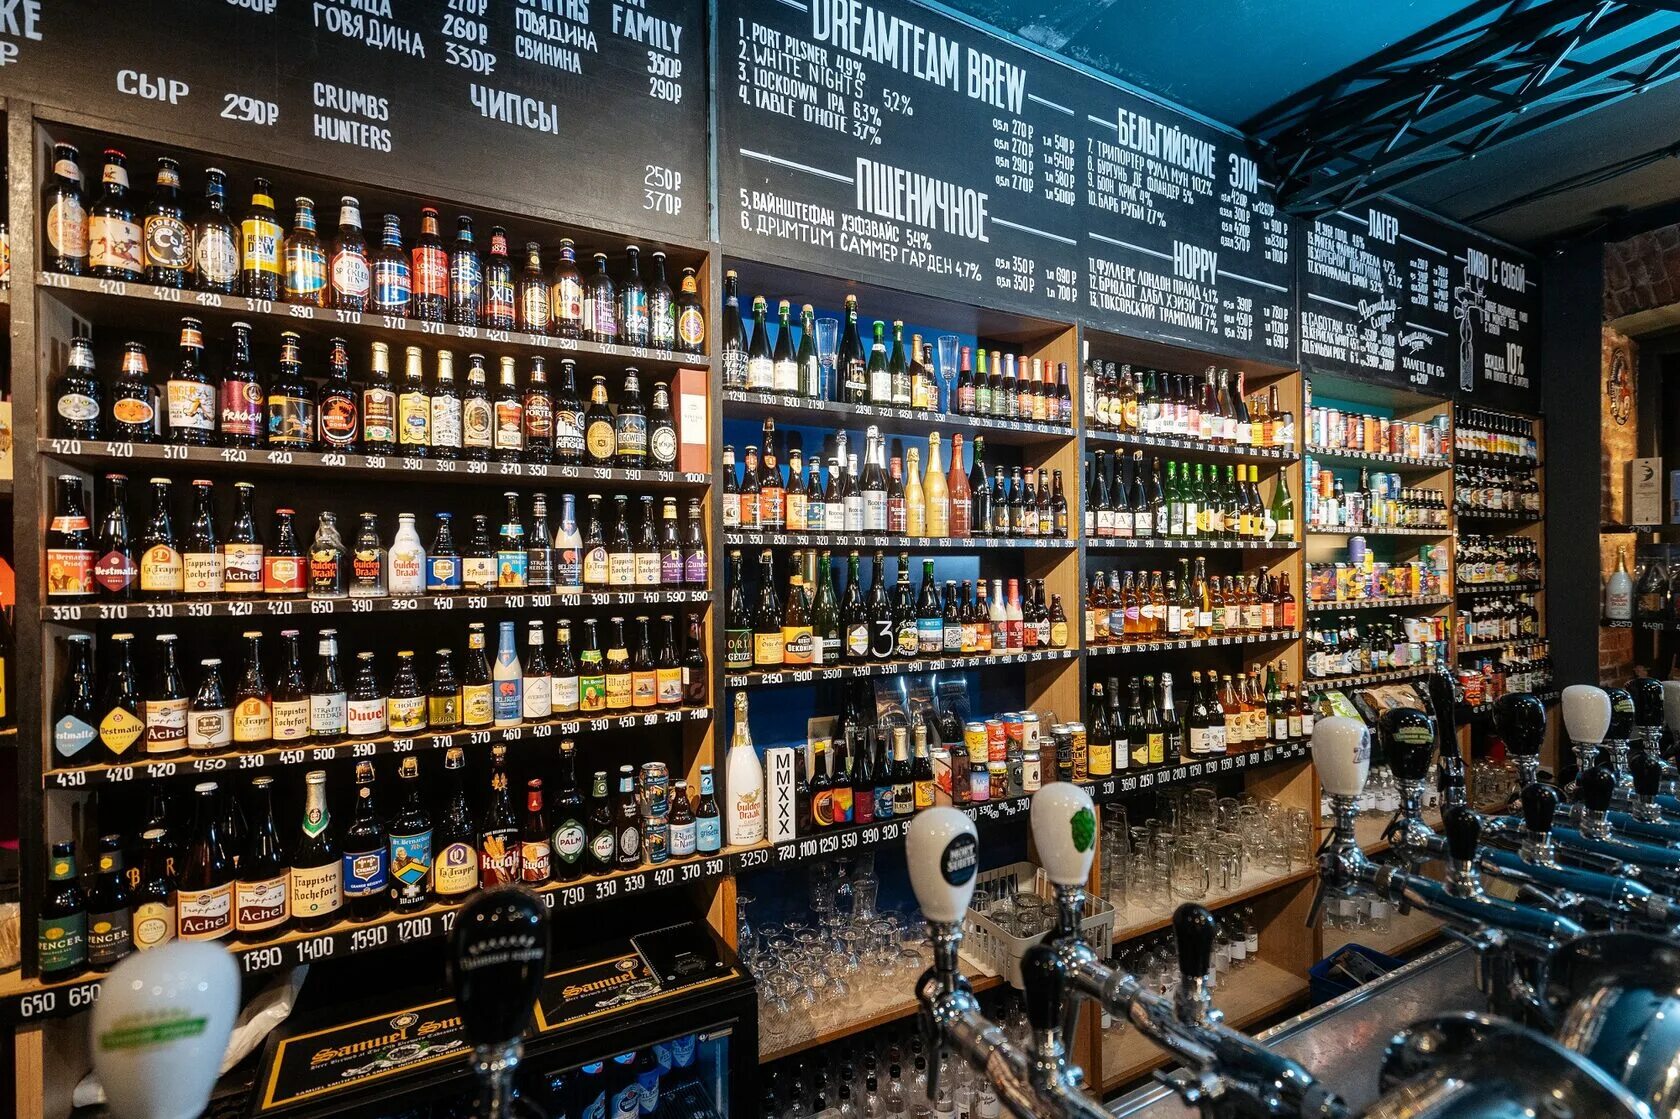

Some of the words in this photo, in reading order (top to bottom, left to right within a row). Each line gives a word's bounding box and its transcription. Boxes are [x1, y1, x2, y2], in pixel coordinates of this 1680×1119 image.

[313, 2, 425, 59] ГОВЯДИНА
[515, 7, 598, 53] ГОВЯДИНА
[612, 4, 683, 54] FAMILY
[752, 22, 781, 49] PORT
[785, 34, 828, 67] PILSNER
[515, 35, 582, 74] СВИНИНА
[812, 0, 959, 92] DREAMTEAM
[967, 47, 1026, 115] BREW
[117, 69, 189, 104] СЫР
[754, 67, 817, 104] LOCKDOWN
[827, 92, 845, 114] IPA
[313, 82, 389, 121] CRUMBS
[470, 84, 558, 135] ЧИПСЫ
[754, 87, 796, 118] TABLE
[314, 113, 391, 152] HUNTERS
[1118, 107, 1216, 180] БЕЛЬГИЙСКИЕ
[1228, 153, 1258, 194] ЭЛИ
[1097, 140, 1145, 171] ТРИПОРТЕР
[1171, 167, 1189, 187] МУН
[1097, 158, 1128, 183] БУРГУНЬ
[1146, 175, 1180, 200] ФЛАНДЕР
[1097, 175, 1115, 194] БООН
[1118, 181, 1137, 202] КРИК
[856, 156, 990, 243] ПШЕНИЧНОЕ
[1098, 192, 1119, 213] БАРБ
[1120, 200, 1144, 221] РУБИ
[1368, 208, 1399, 245] ЛАГЕР
[248, 242, 274, 255] DEW
[756, 214, 834, 248] ДРИМТИМ
[840, 231, 898, 262] САММЕР
[901, 247, 952, 275] ГАРДЕН
[1173, 239, 1218, 286] HOPPY
[1467, 247, 1489, 281] ПИВО
[42, 272, 69, 288] 370
[99, 280, 126, 296] 420
[1137, 270, 1171, 293] ЛОНДОН
[247, 297, 271, 314] 370
[383, 315, 406, 330] 370
[52, 439, 81, 455] 420
[163, 444, 188, 460] 370
[366, 455, 385, 469] 390
[225, 569, 260, 581] Achel
[228, 601, 253, 616] 420
[311, 600, 334, 614] 650
[532, 594, 551, 607] 500
[52, 605, 81, 621] 350
[100, 605, 128, 620] 370
[349, 706, 385, 721] Duvel
[149, 725, 187, 741] Achel
[313, 747, 336, 760] 500
[352, 743, 376, 757] 390
[147, 762, 176, 778] 420
[239, 754, 264, 769] 330
[57, 771, 86, 787] 430
[559, 836, 581, 847] PALM
[841, 833, 858, 849] 550
[705, 858, 723, 875] 330
[740, 850, 768, 868] 3250
[294, 872, 337, 888] Trappistes
[654, 868, 674, 886] 420
[294, 884, 337, 901] Rochefort
[562, 886, 585, 906] 790
[241, 904, 284, 922] Achel
[183, 916, 229, 933] Achel
[296, 936, 334, 962] 1400
[243, 947, 282, 972] 1390
[20, 992, 55, 1017] 650
